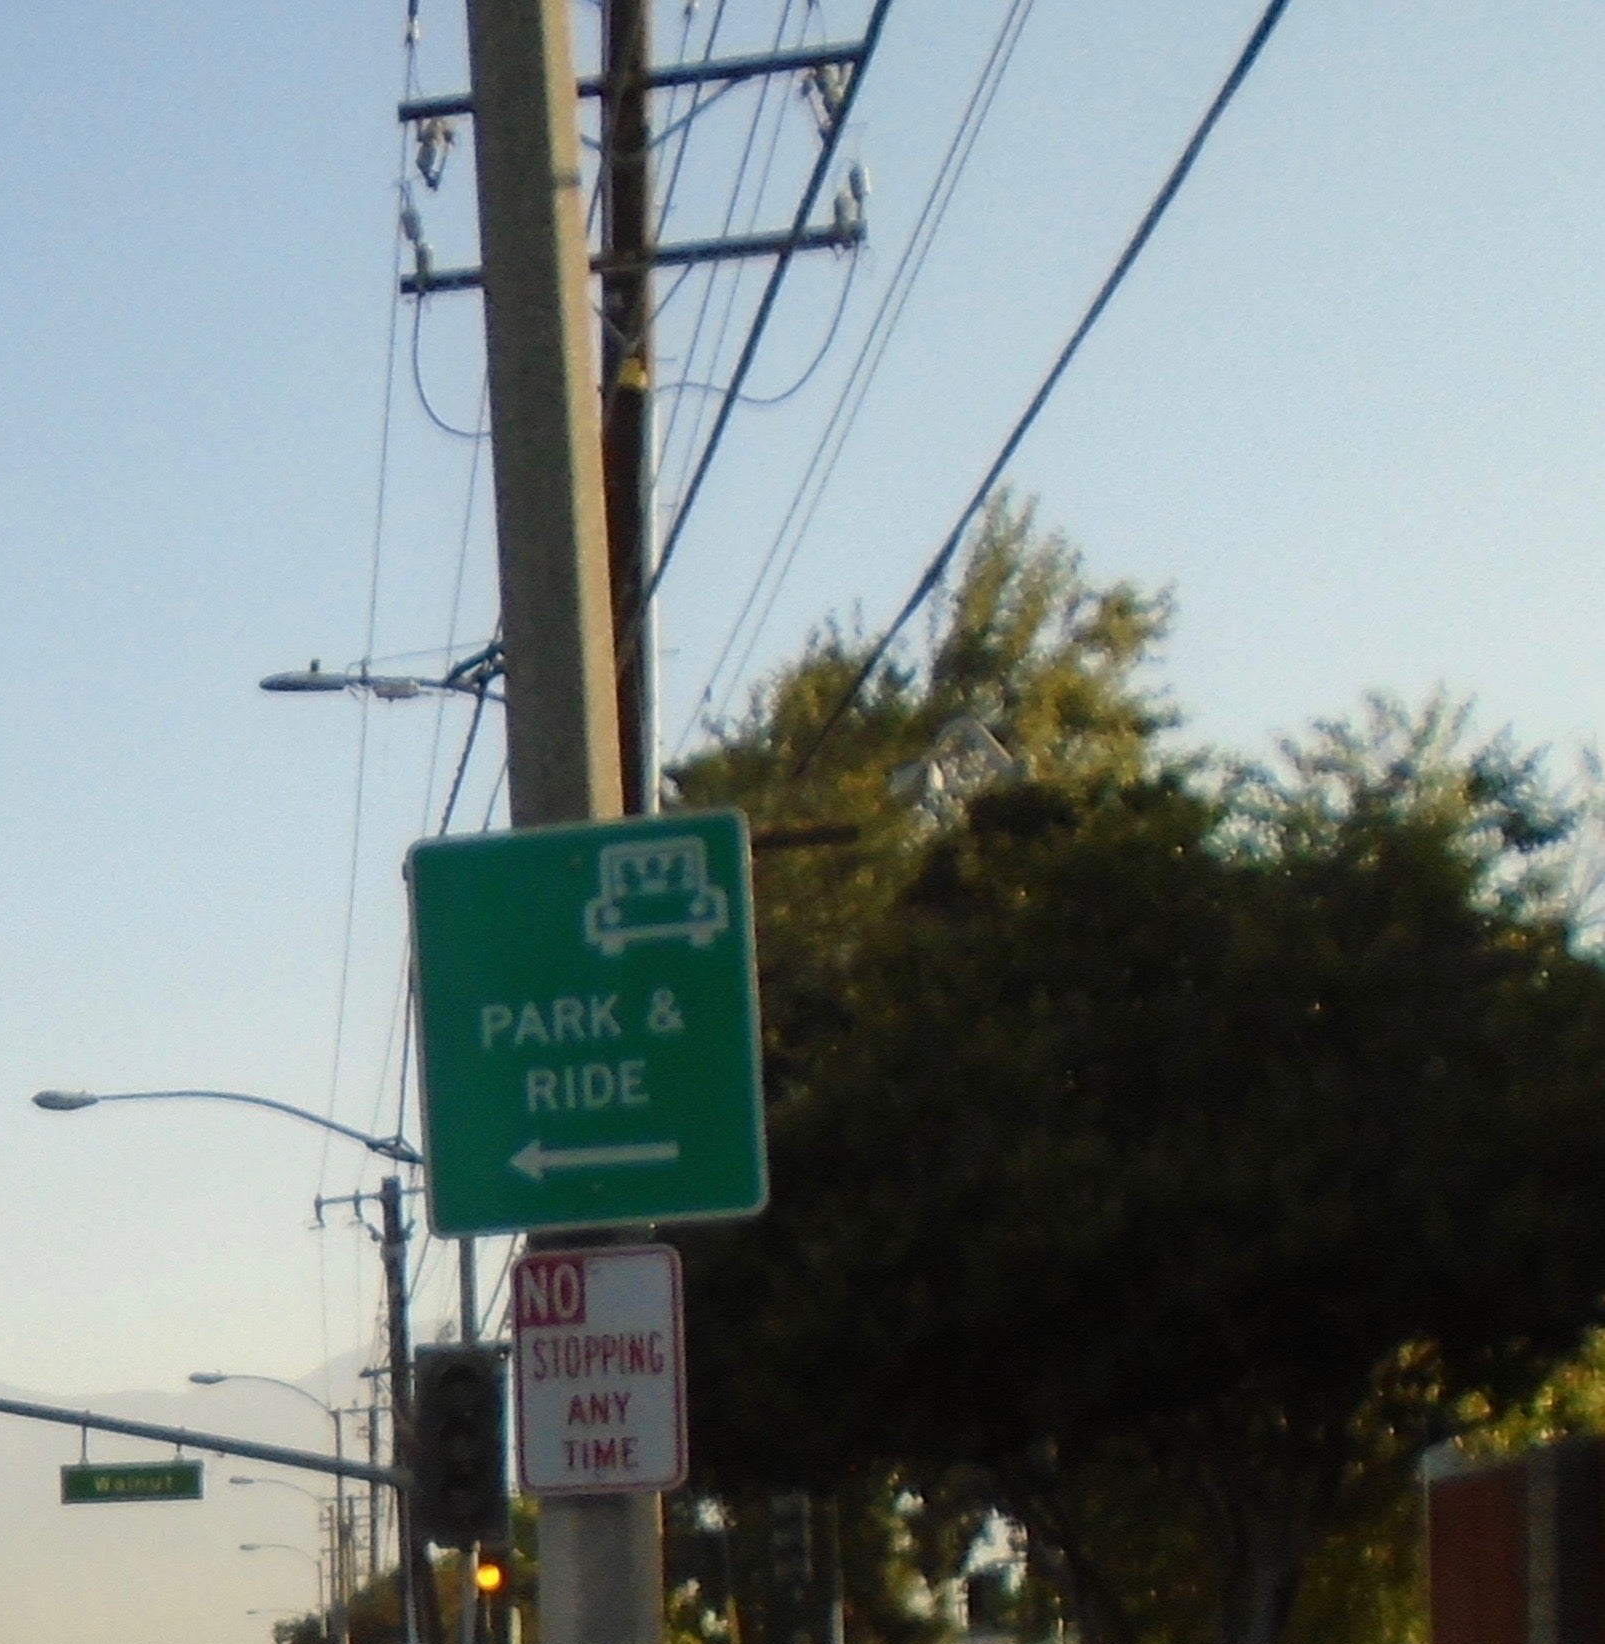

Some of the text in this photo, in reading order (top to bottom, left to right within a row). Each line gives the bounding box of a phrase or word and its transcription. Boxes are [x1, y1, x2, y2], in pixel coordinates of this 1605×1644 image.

[481, 988, 685, 1050] PARK &
[526, 1060, 651, 1113] RIDE
[522, 1262, 579, 1321] NO
[532, 1331, 665, 1381] STOPPING
[567, 1390, 631, 1427] ANY
[563, 1436, 640, 1471] TIME
